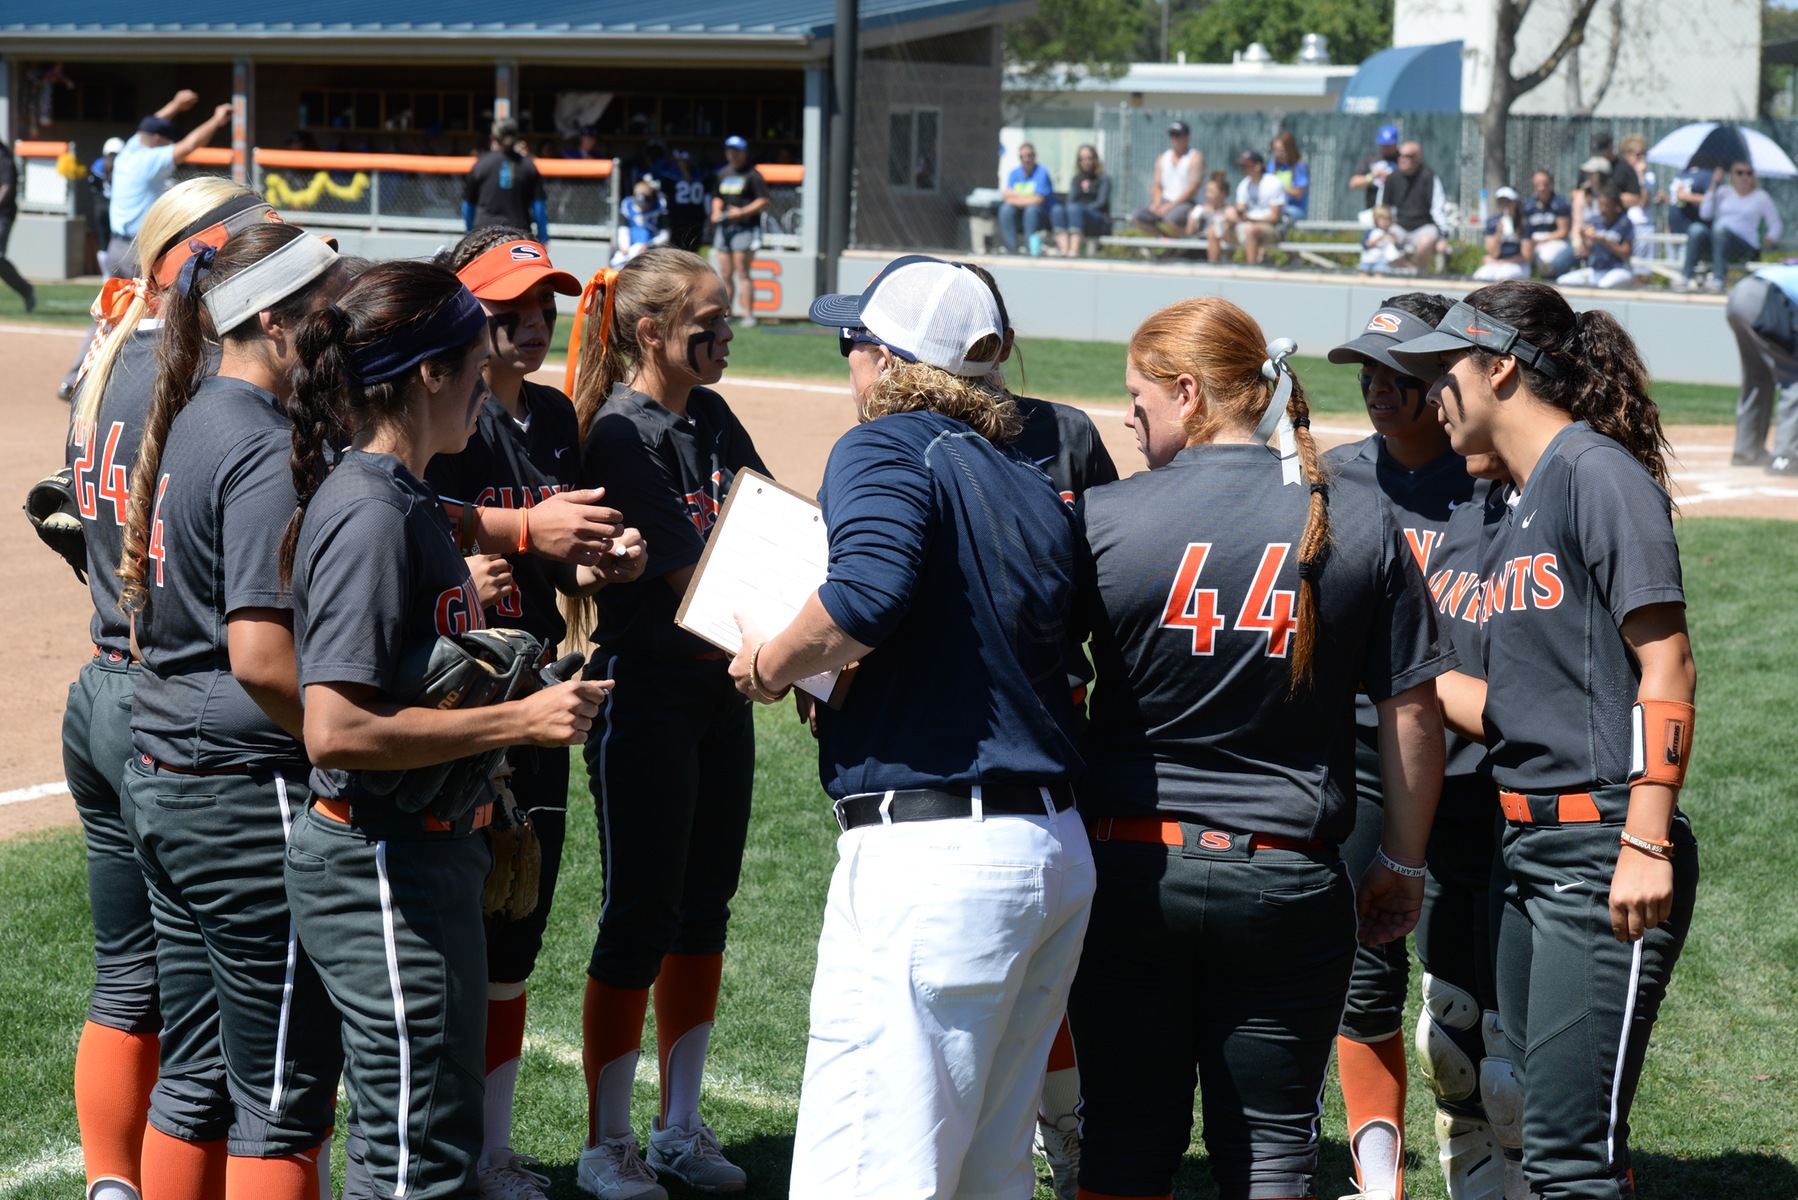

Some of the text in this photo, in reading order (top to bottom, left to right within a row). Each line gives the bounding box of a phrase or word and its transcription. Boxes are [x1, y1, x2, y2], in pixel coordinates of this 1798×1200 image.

[675, 180, 704, 205] 20
[509, 244, 543, 261] S
[1367, 313, 1402, 333] S
[74, 415, 130, 526] 24
[1158, 542, 1298, 659] 44
[1200, 830, 1231, 849] S
[1630, 836, 1652, 850] SIERRA
[1396, 866, 1422, 877] HEART
